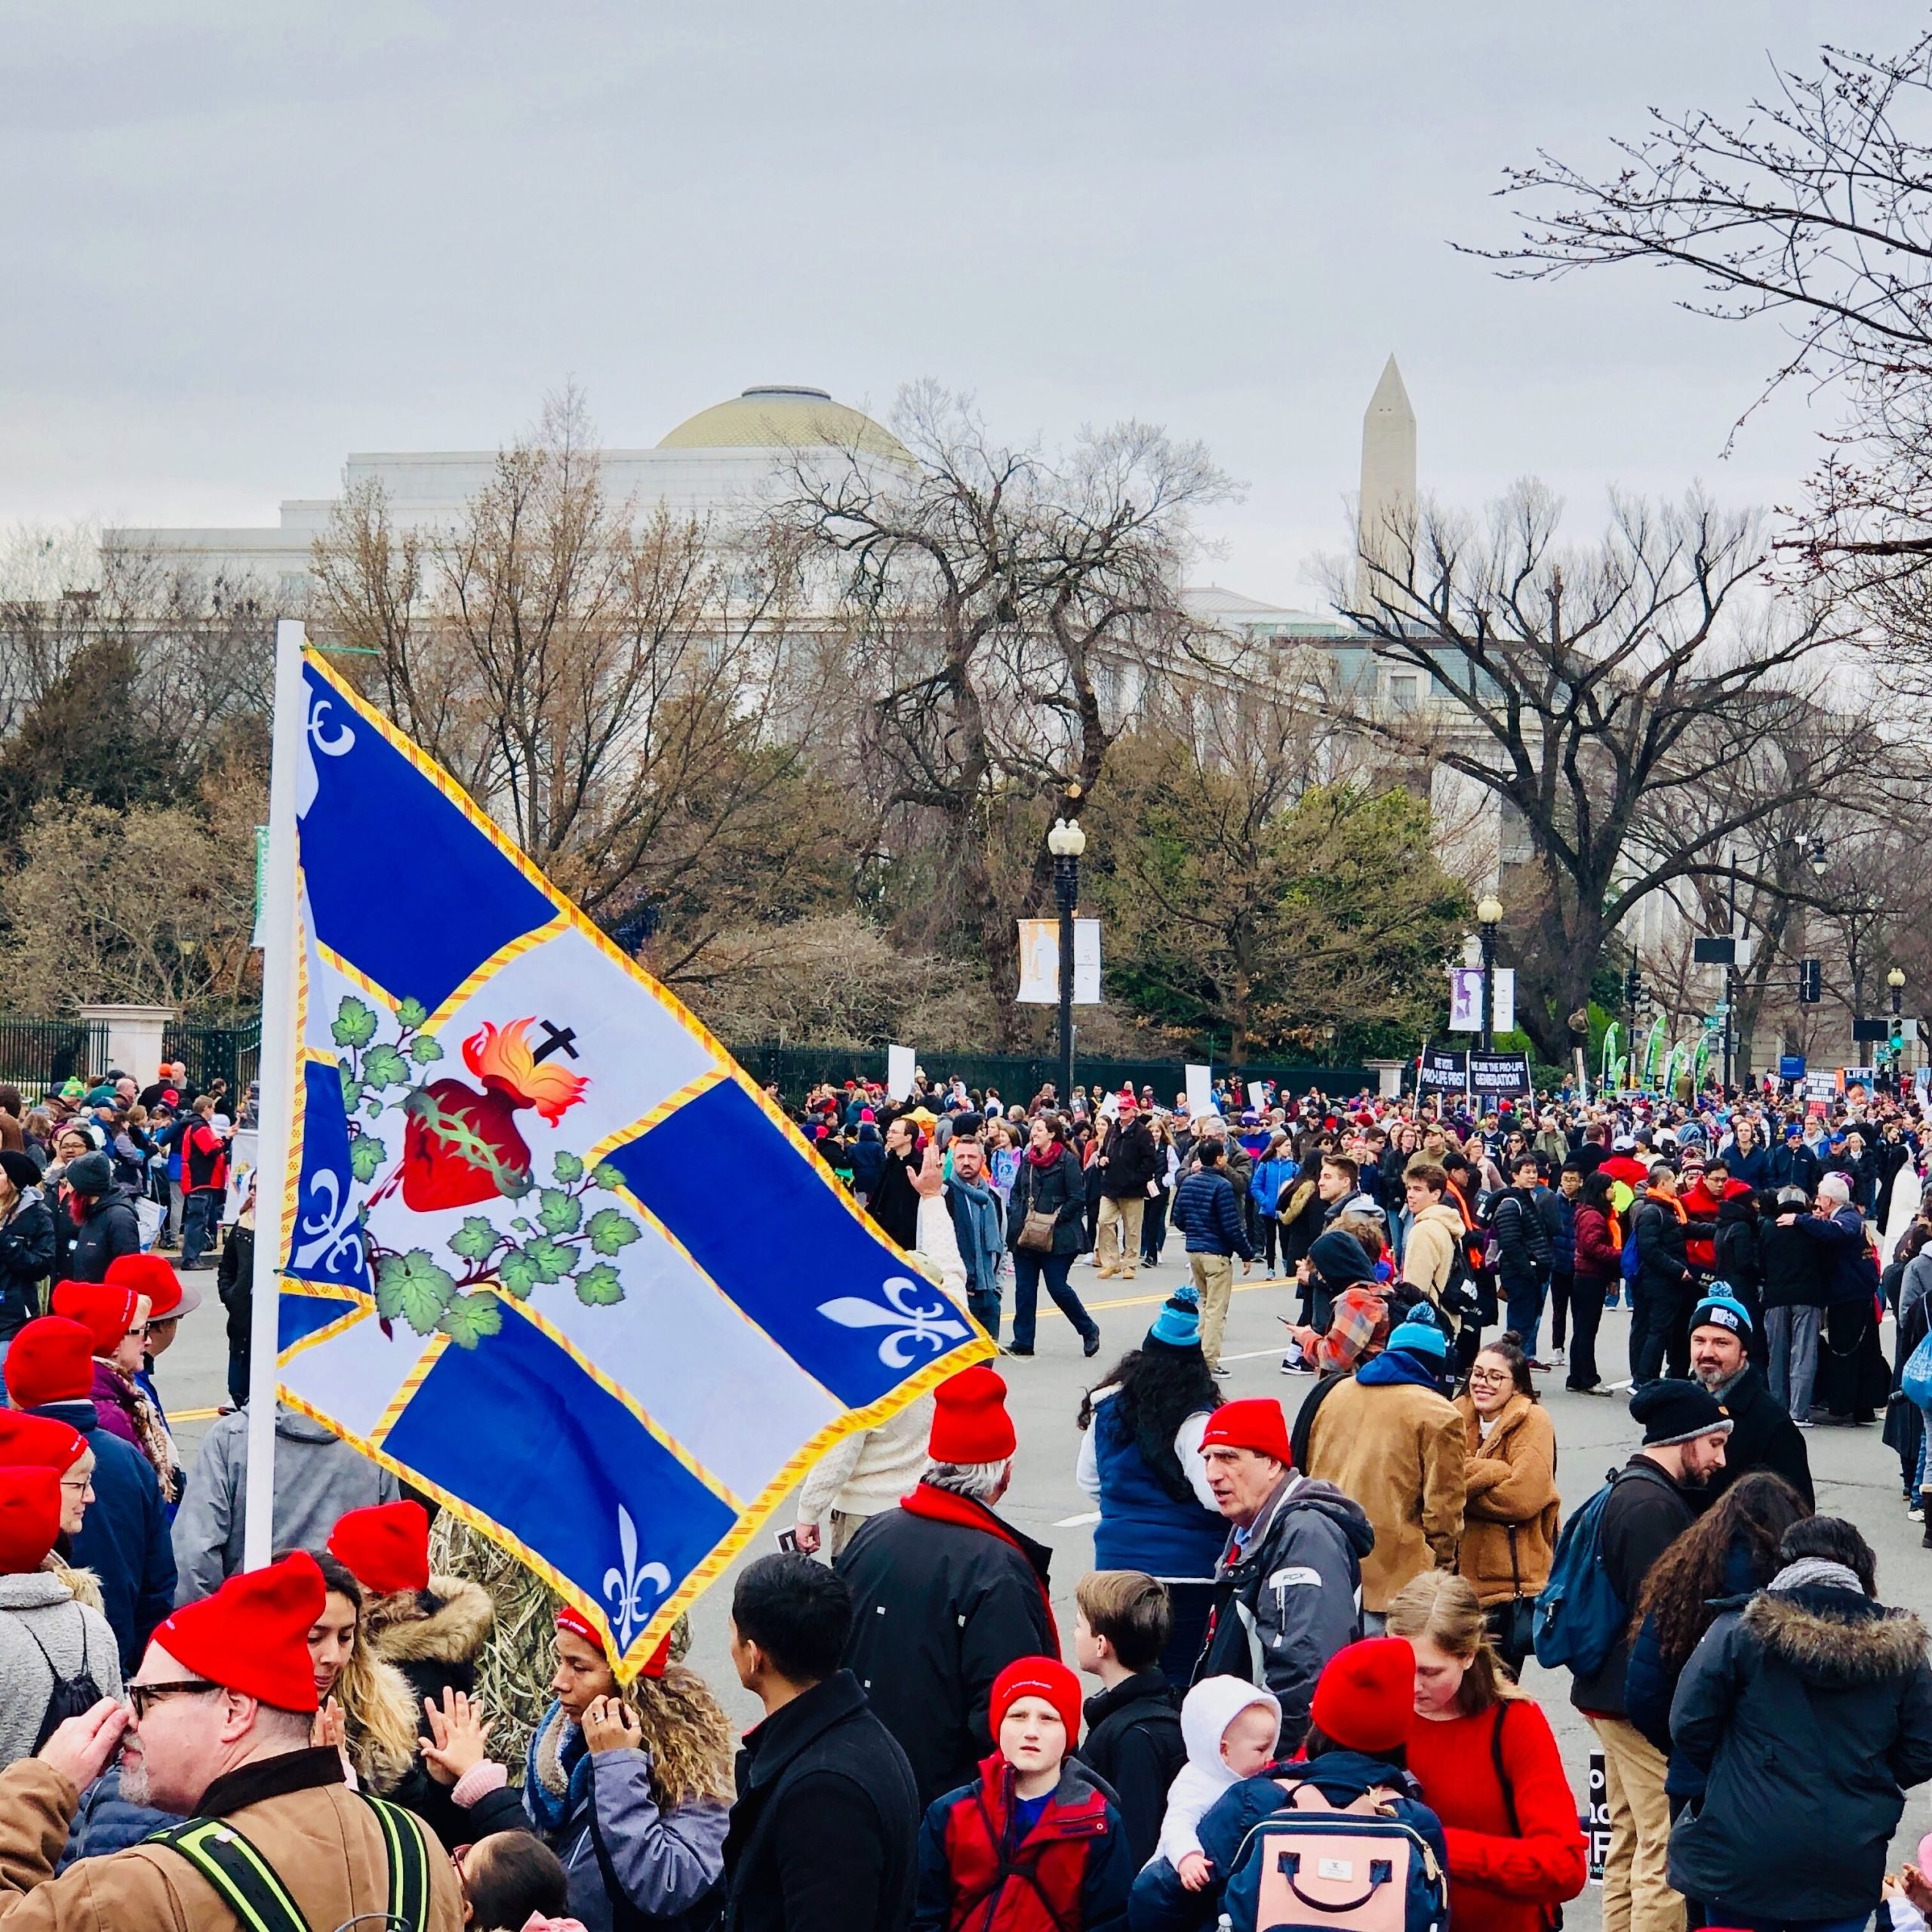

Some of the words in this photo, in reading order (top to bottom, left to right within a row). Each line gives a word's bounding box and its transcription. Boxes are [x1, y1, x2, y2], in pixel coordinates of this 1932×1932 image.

[1488, 1062, 1499, 1072] THE
[1499, 1061, 1525, 1072] PRO-LIFE
[1422, 1067, 1448, 1085] PRO-LIFE
[1448, 1072, 1466, 1086] FIRST
[1475, 1072, 1521, 1086] GENERATION
[1846, 1070, 1869, 1078] LIFE
